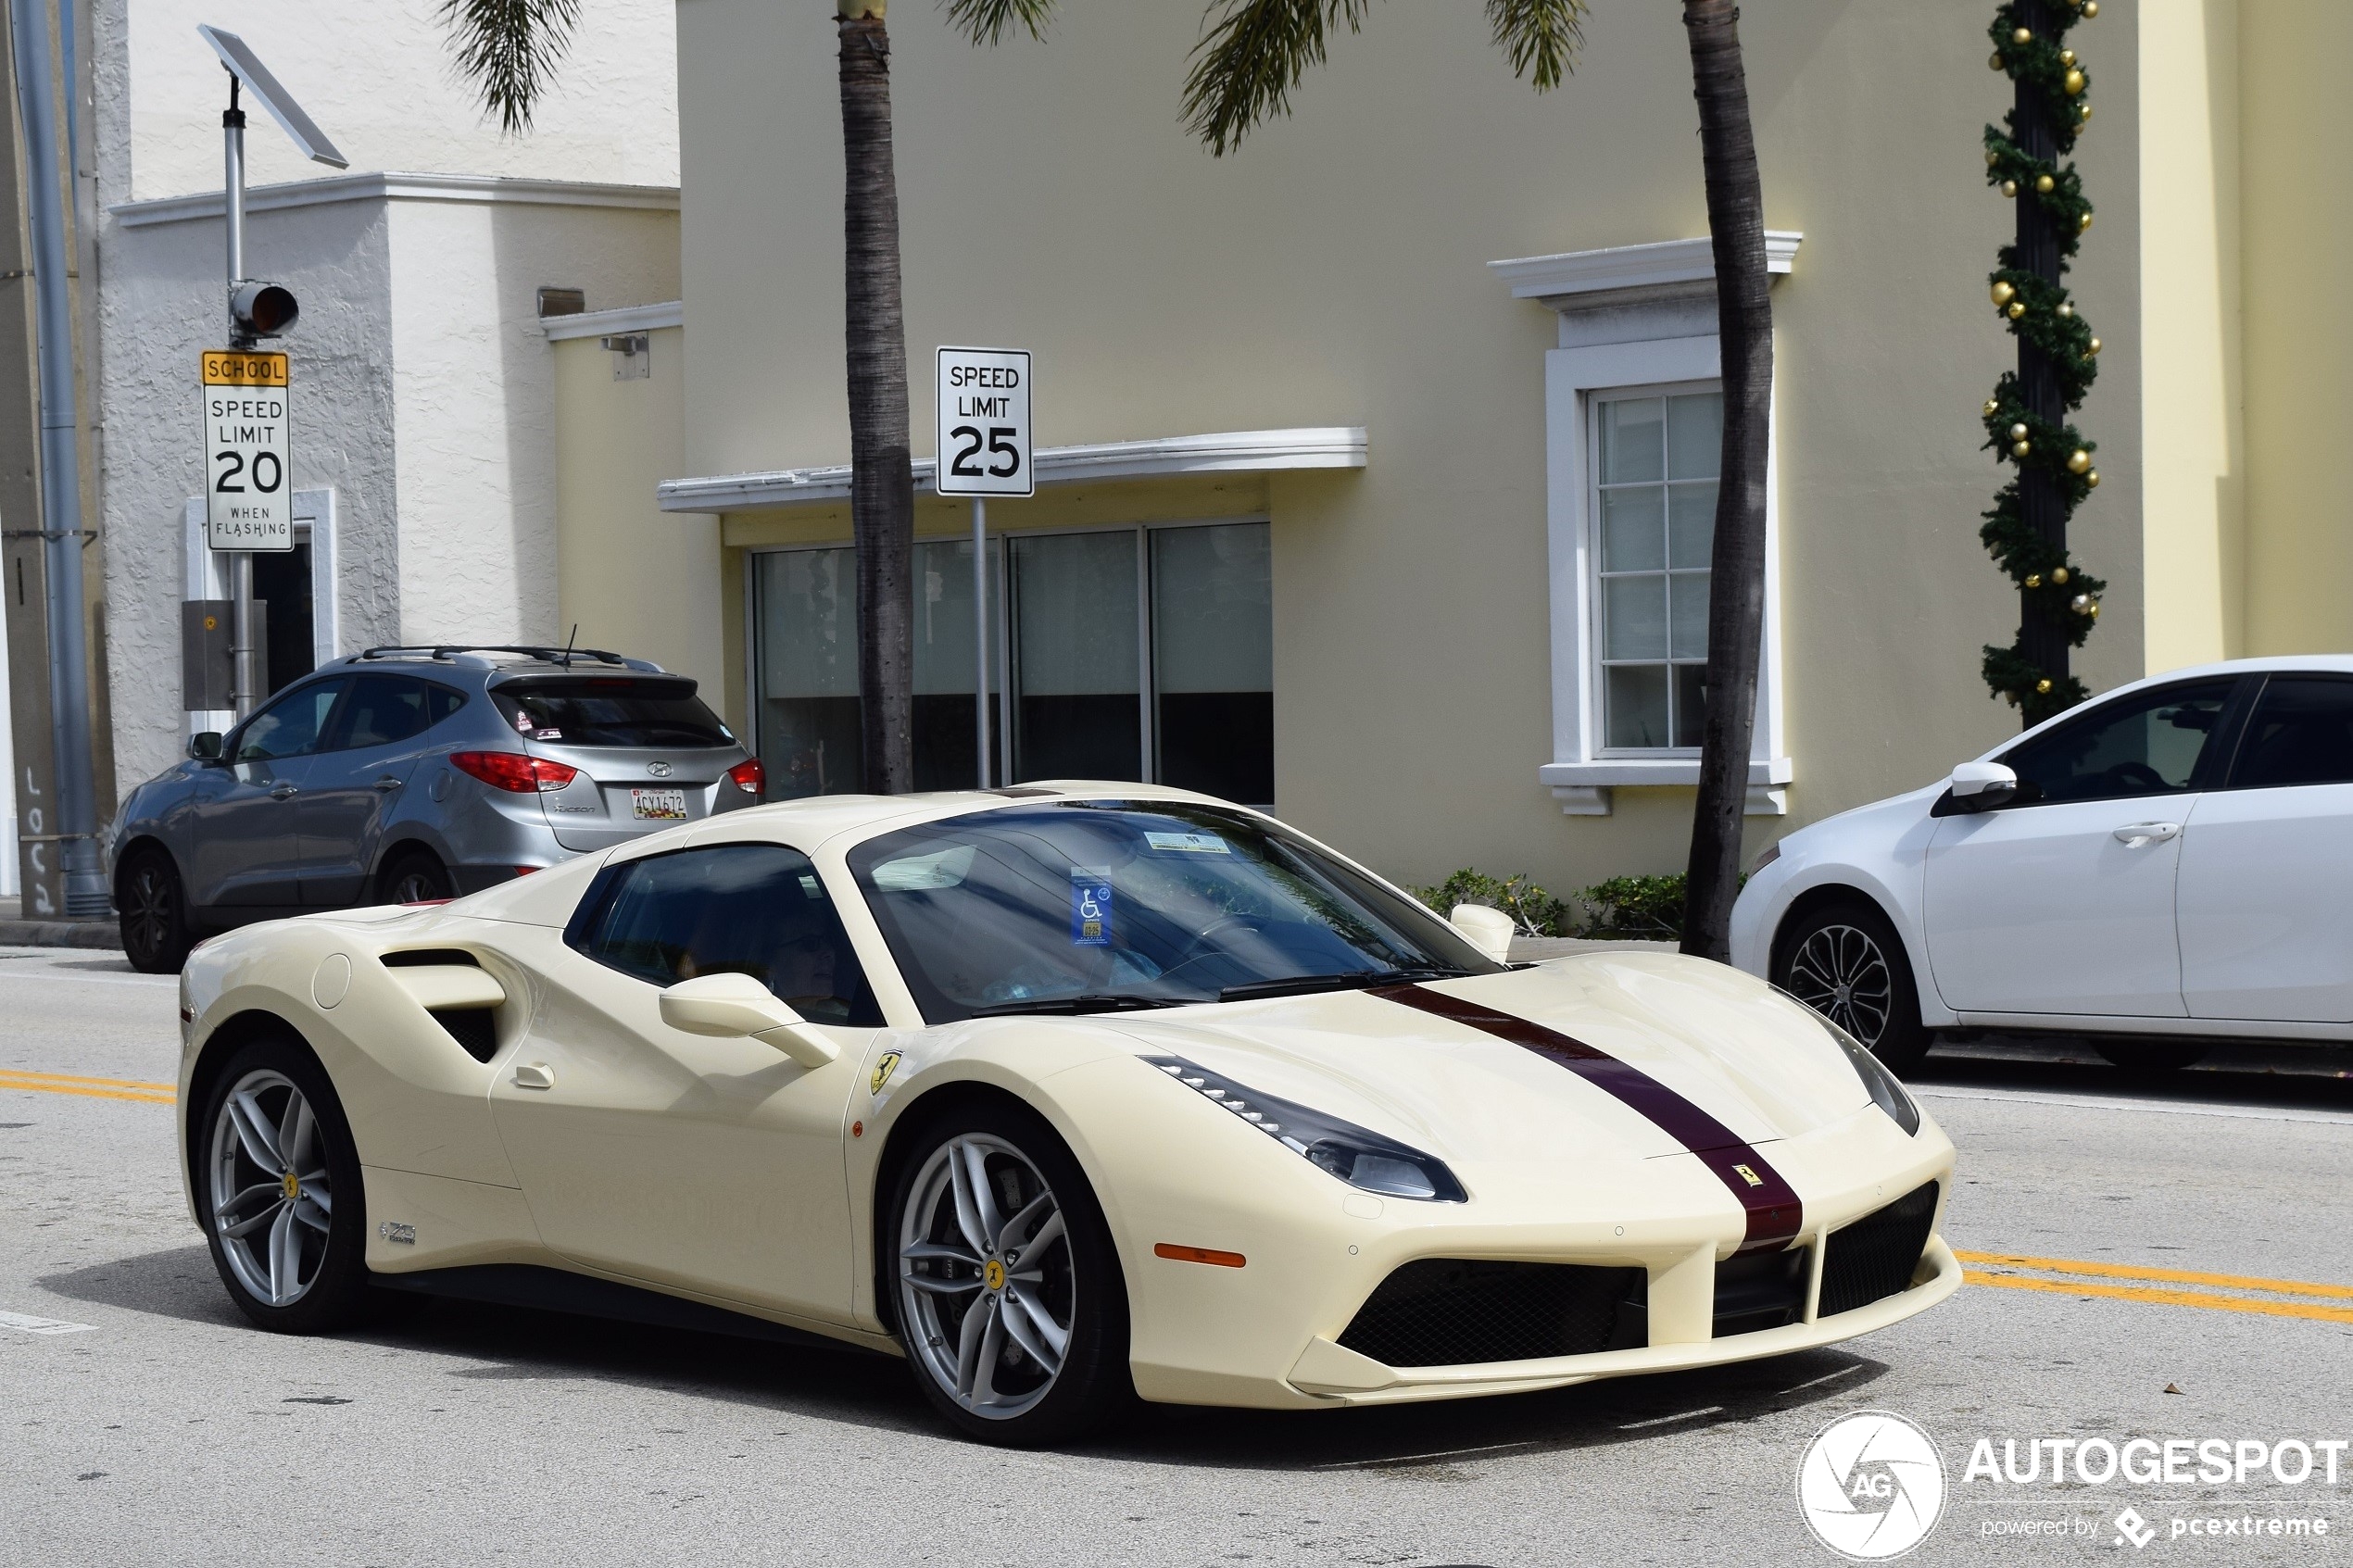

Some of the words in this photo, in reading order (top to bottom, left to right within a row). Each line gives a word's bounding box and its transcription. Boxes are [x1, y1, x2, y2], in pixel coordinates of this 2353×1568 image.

[208, 359, 283, 379] SCHOOL
[950, 366, 1019, 388] SPEED
[212, 400, 282, 419] SPEED
[959, 395, 1011, 418] LIMIT
[220, 425, 275, 443] LIMIT
[950, 425, 1020, 478] 25
[215, 450, 283, 494] 20
[231, 508, 270, 519] WHEN
[216, 522, 286, 534] FLASHING
[635, 796, 685, 813] 4CY1672
